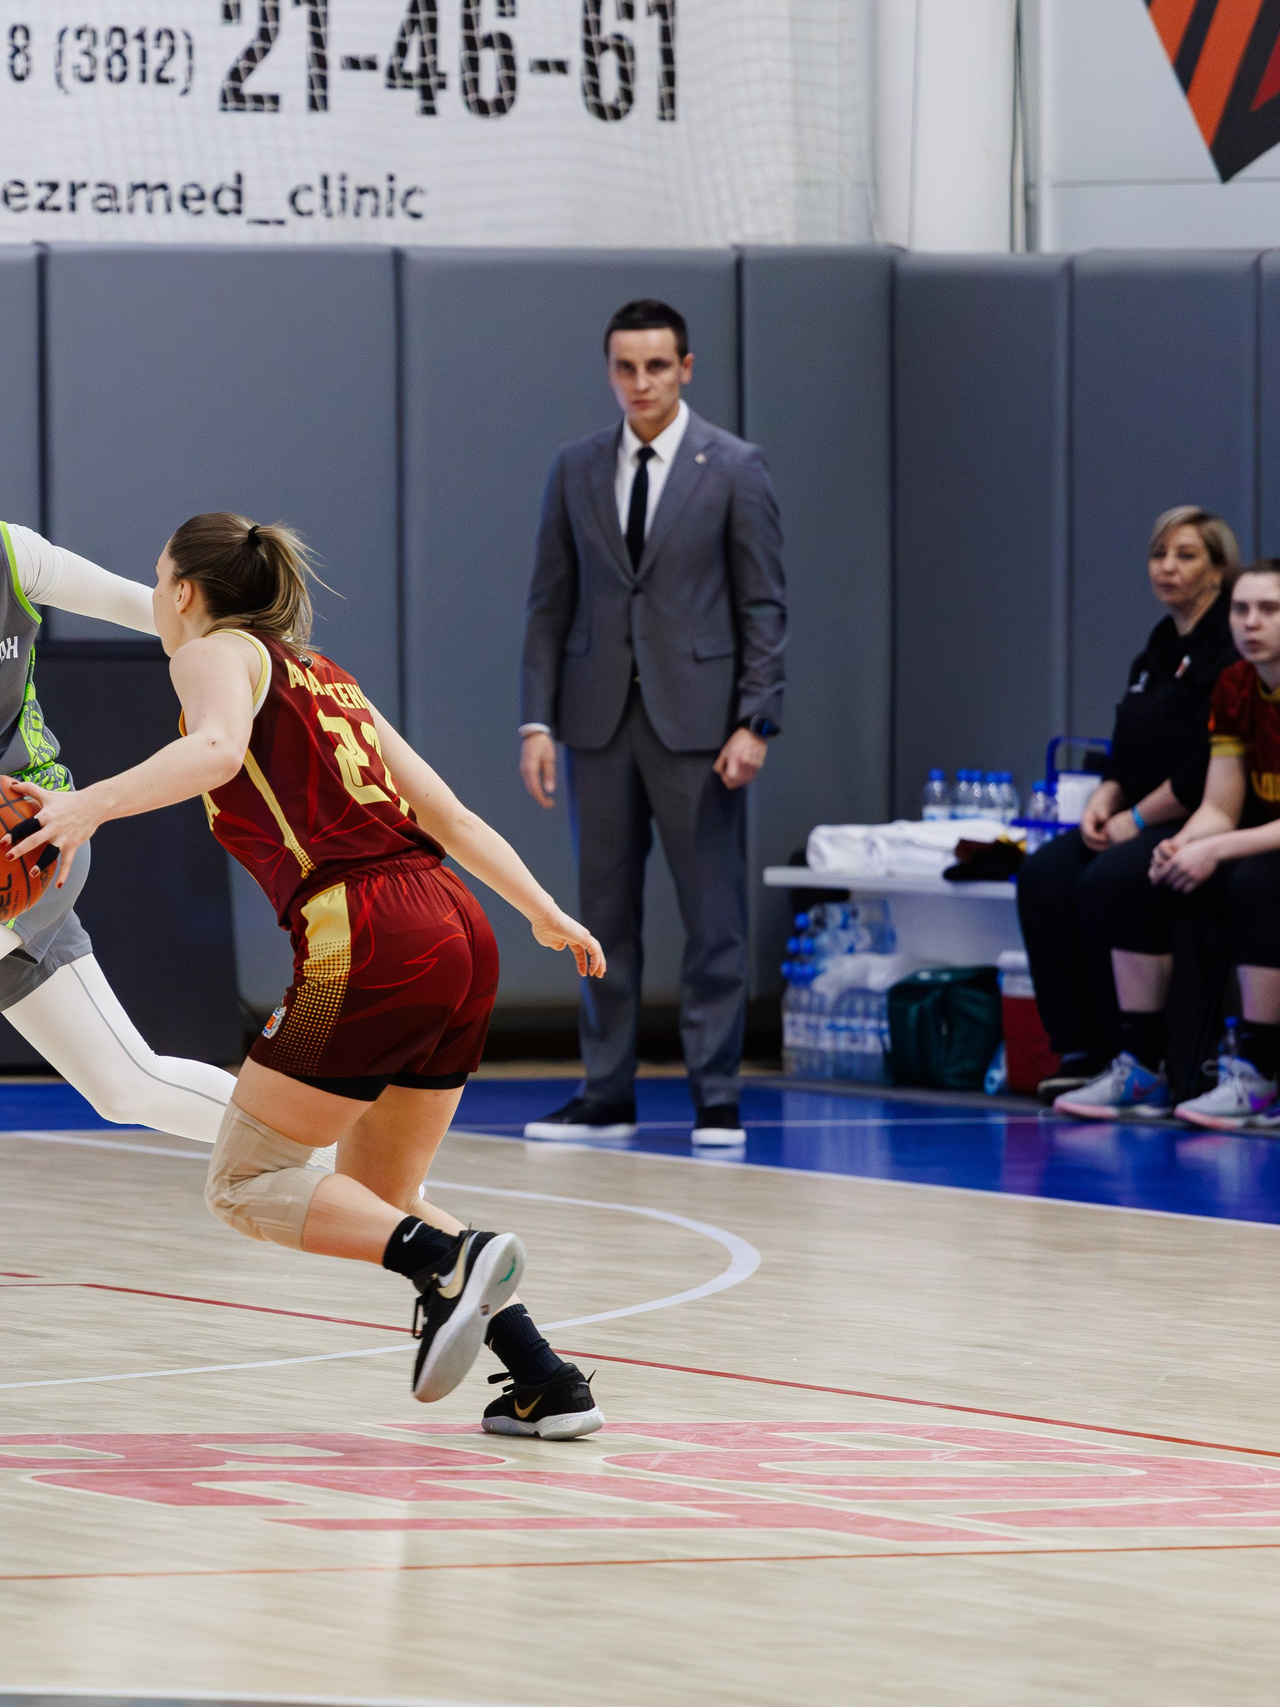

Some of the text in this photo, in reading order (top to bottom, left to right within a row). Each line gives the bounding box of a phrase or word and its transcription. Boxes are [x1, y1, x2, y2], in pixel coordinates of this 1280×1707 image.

[9, 0, 677, 122] 8 (3812) 21-46-61
[1, 172, 427, 226] ezramed_clinic
